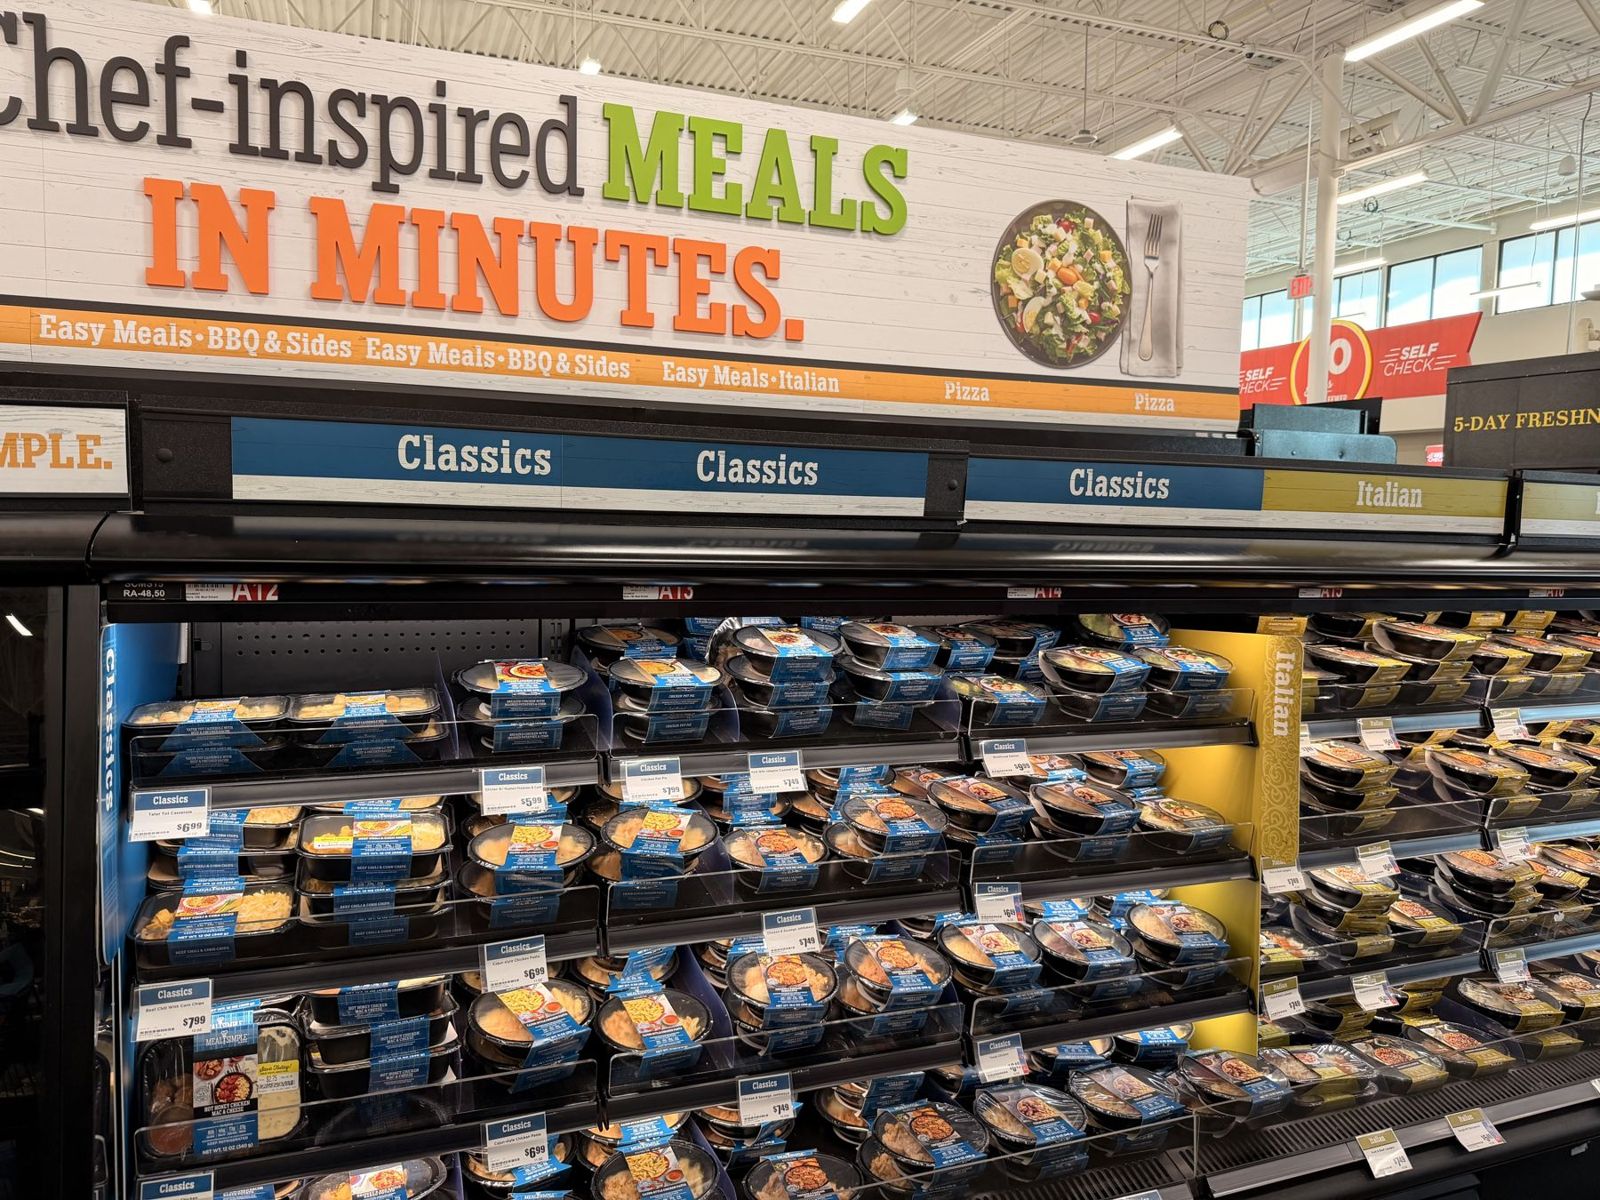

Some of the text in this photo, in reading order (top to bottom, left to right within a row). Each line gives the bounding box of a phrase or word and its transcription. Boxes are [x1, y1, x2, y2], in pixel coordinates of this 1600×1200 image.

[602, 102, 909, 236] MEALS
[143, 177, 804, 342] IN MINUTES.
[38, 313, 353, 359] Easy Meals BBQ & Sides
[365, 336, 630, 379] Easy Meals BBQ & Sides
[1399, 342, 1440, 360] SELF
[1244, 367, 1275, 382] SELF
[1383, 358, 1435, 377] CHECK
[661, 360, 840, 394] Easy Meals Italian
[944, 380, 990, 403] Pizza
[1133, 391, 1176, 414] Pizza
[1453, 406, 1600, 433] 5-DAY FRESHN
[396, 432, 552, 478] Classics
[695, 449, 819, 487] Classics
[1068, 467, 1170, 500] Classics
[1356, 480, 1423, 508] Italian
[1273, 650, 1296, 737] Italian
[105, 647, 116, 812] Classics
[640, 763, 667, 772] Classics
[761, 755, 786, 764] Classics
[498, 771, 528, 781] Classics
[152, 794, 189, 805] Classics
[776, 914, 802, 924] Classics
[500, 942, 531, 954] Classics
[523, 967, 545, 979] $699
[157, 987, 193, 999] Classics
[182, 1015, 206, 1029] $799
[752, 1079, 778, 1090] Classics
[502, 1121, 532, 1133] Classics
[524, 1145, 546, 1159] $699
[159, 1181, 195, 1194] Classics
